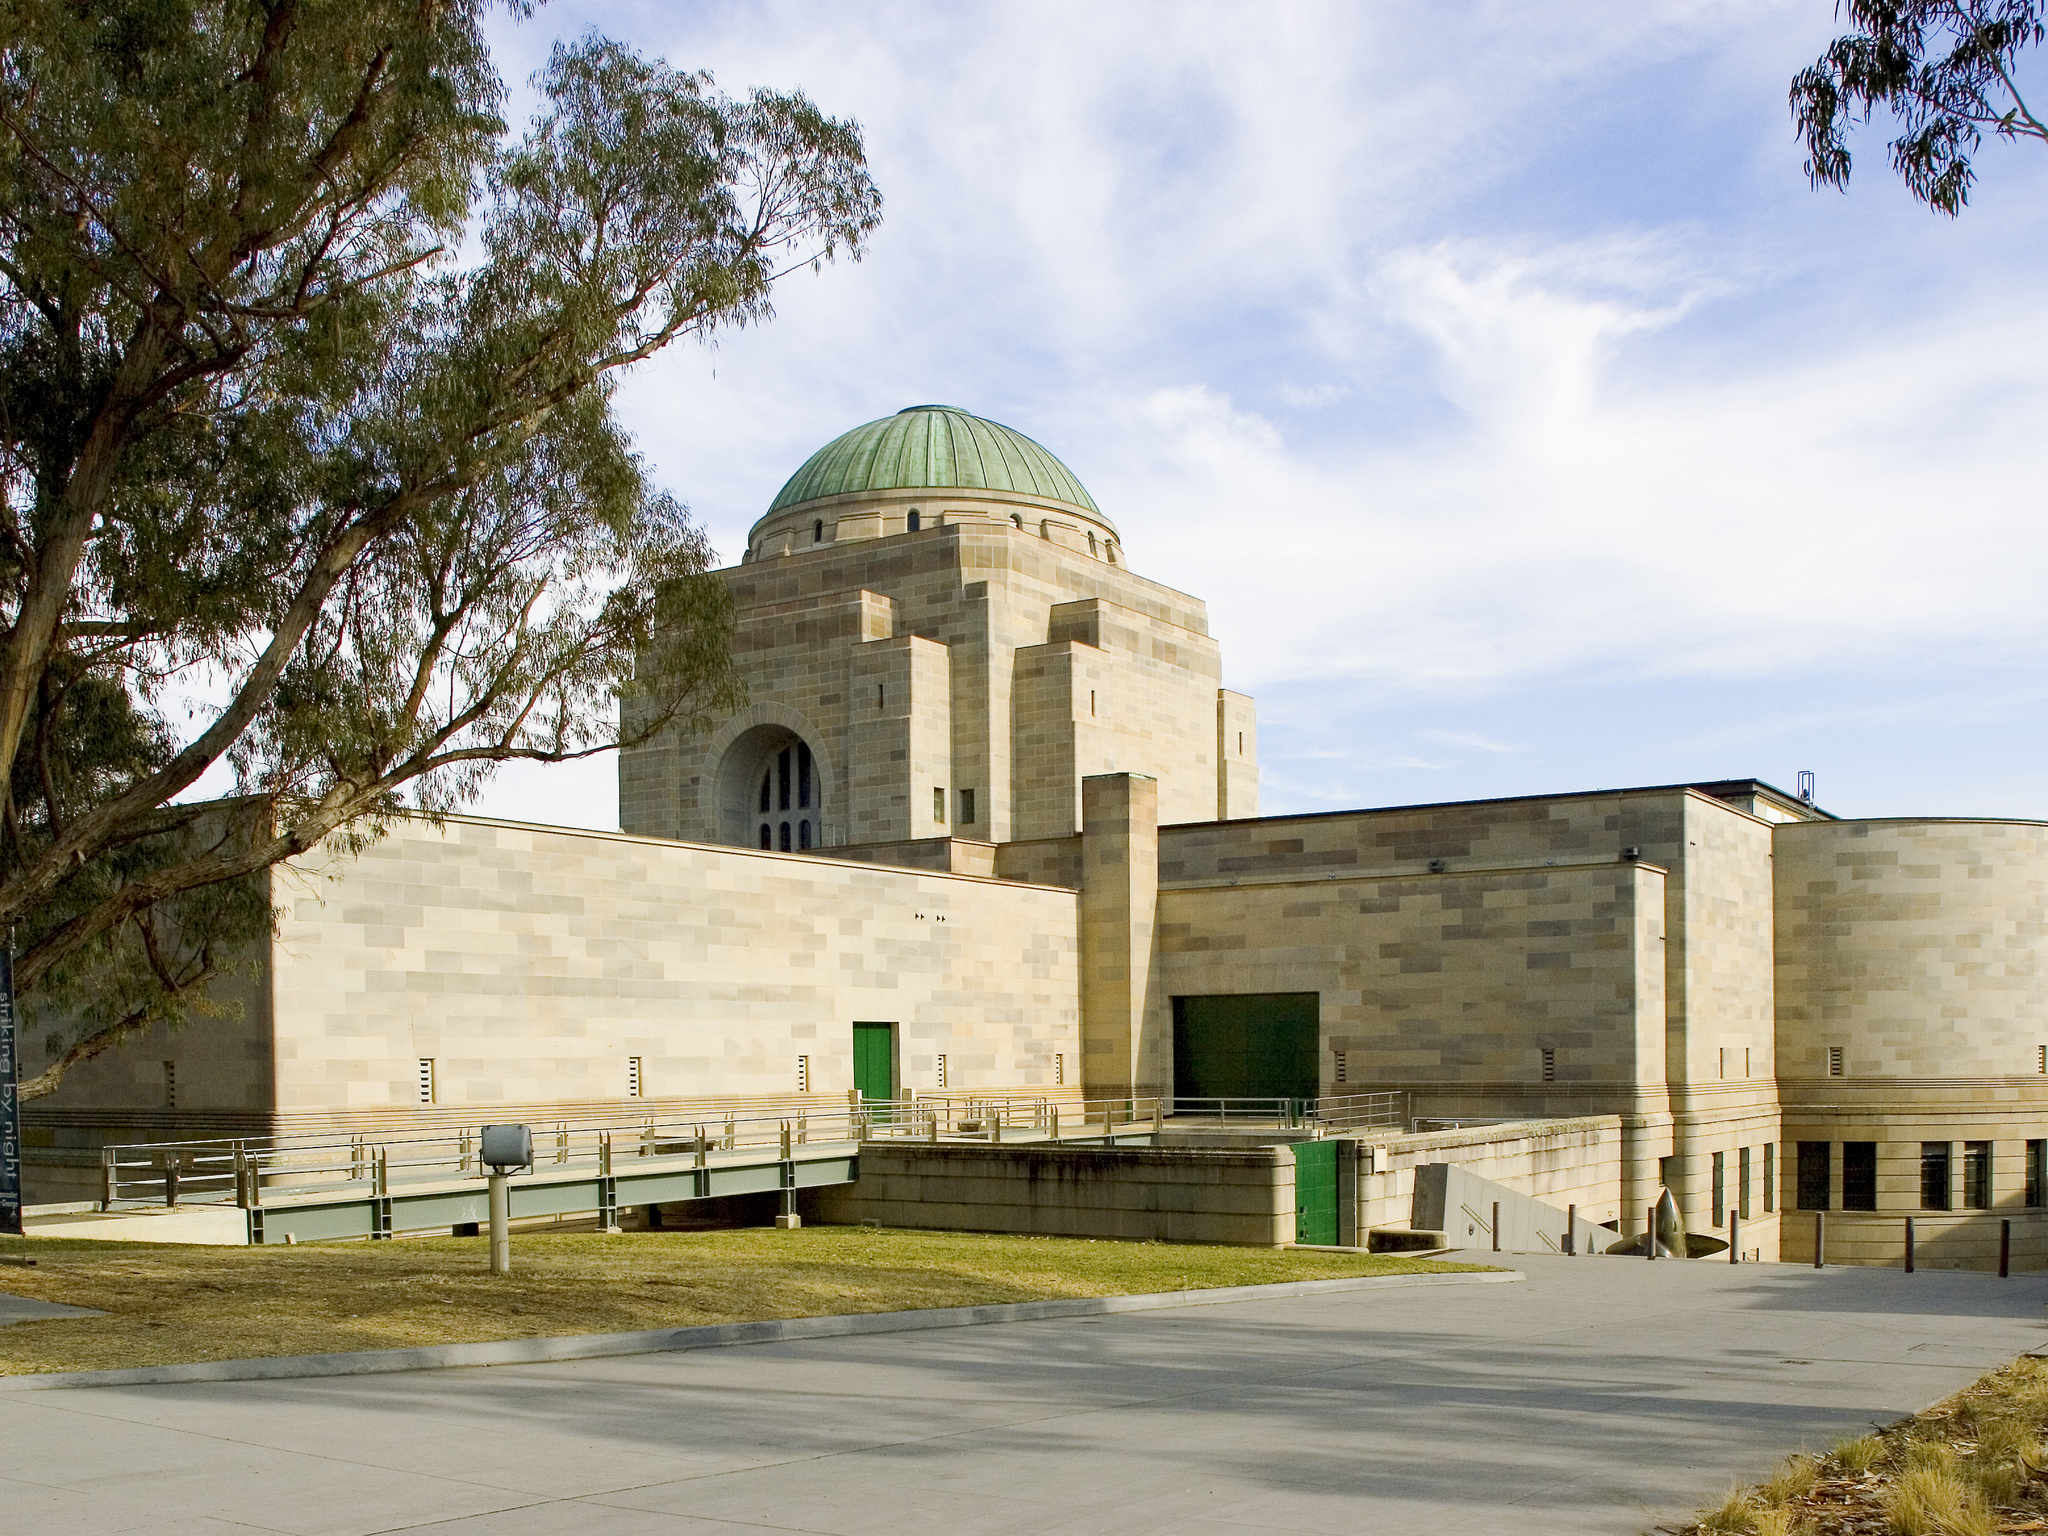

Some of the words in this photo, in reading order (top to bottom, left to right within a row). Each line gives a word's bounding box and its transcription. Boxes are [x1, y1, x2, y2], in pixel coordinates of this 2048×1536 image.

[0, 992, 14, 1072] striking
[1, 1083, 16, 1113] by
[3, 1121, 19, 1176] night
